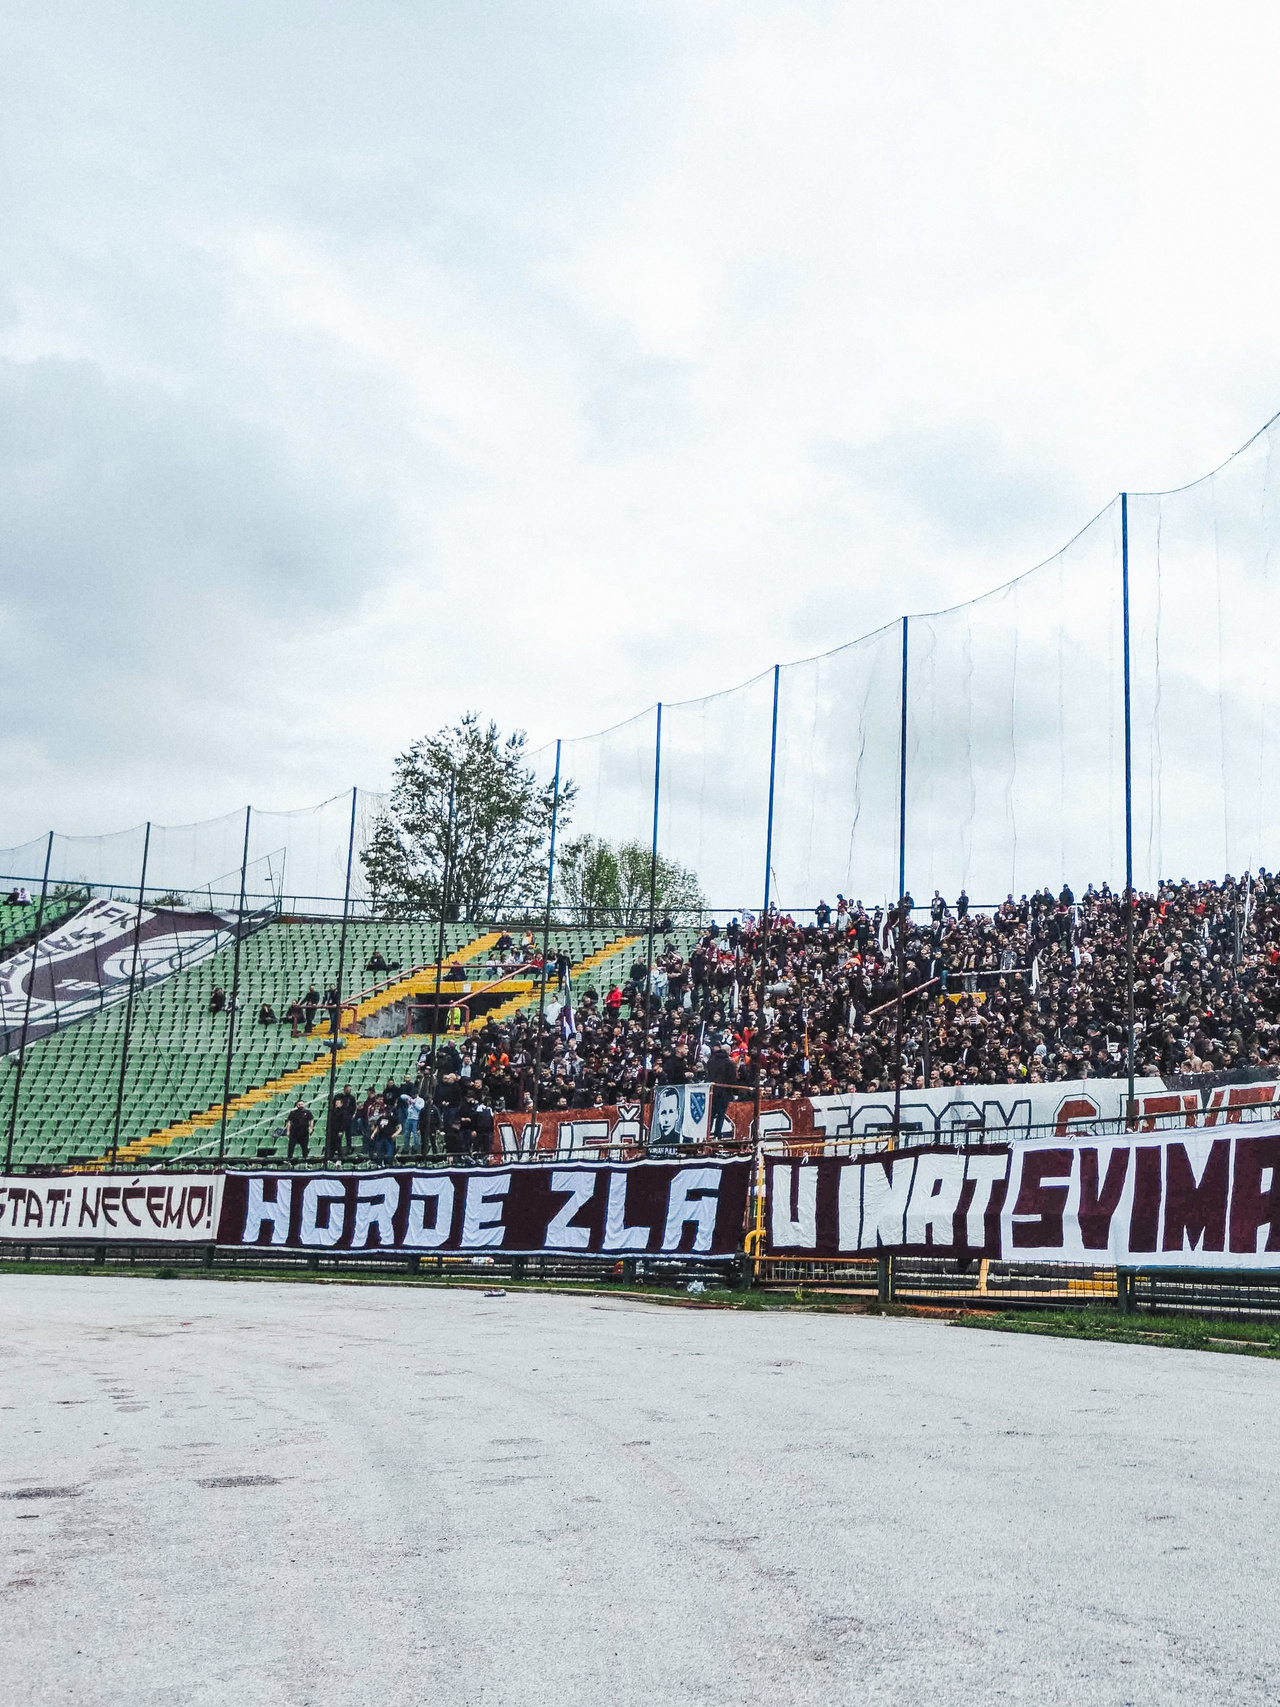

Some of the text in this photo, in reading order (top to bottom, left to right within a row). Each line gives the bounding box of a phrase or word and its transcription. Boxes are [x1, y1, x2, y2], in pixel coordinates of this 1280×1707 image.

[78, 1178, 214, 1229] NEĆEMO!
[545, 1168, 722, 1251] ZLA
[772, 1164, 819, 1249] U
[838, 1153, 1009, 1252] INAT
